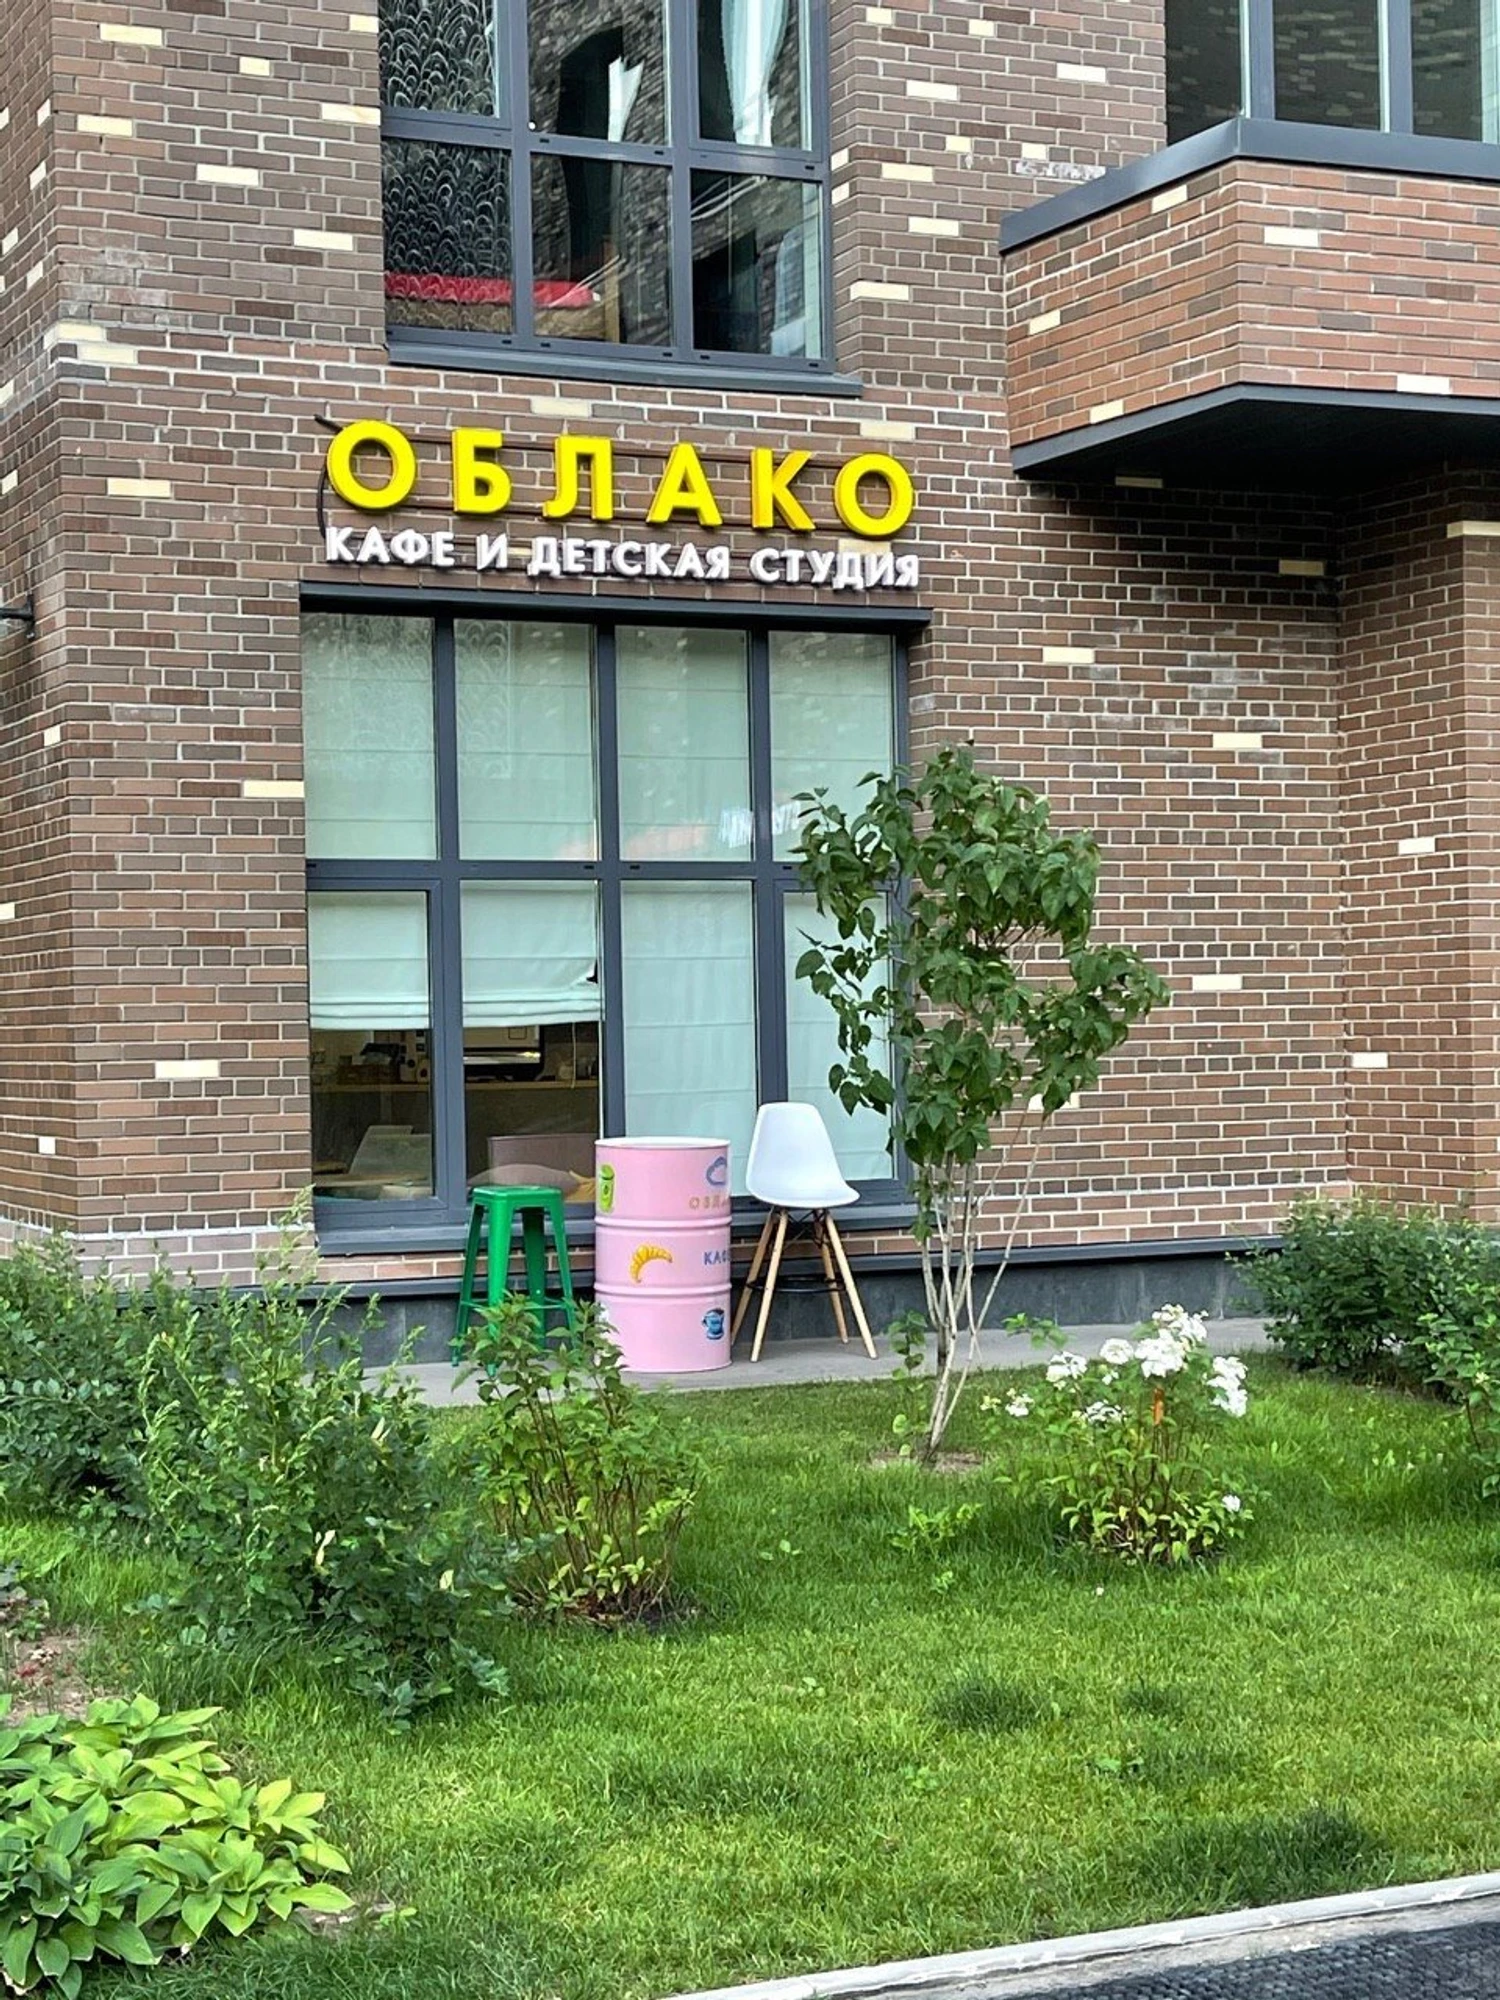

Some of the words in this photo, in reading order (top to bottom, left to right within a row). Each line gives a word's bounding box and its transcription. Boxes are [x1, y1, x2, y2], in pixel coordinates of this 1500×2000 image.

[327, 420, 915, 537] ОБЛАКО
[325, 526, 455, 567] КАФЕ
[476, 533, 509, 571] И
[527, 538, 730, 580] ДЕТСКАЯ
[749, 548, 919, 590] СТУДИЯ
